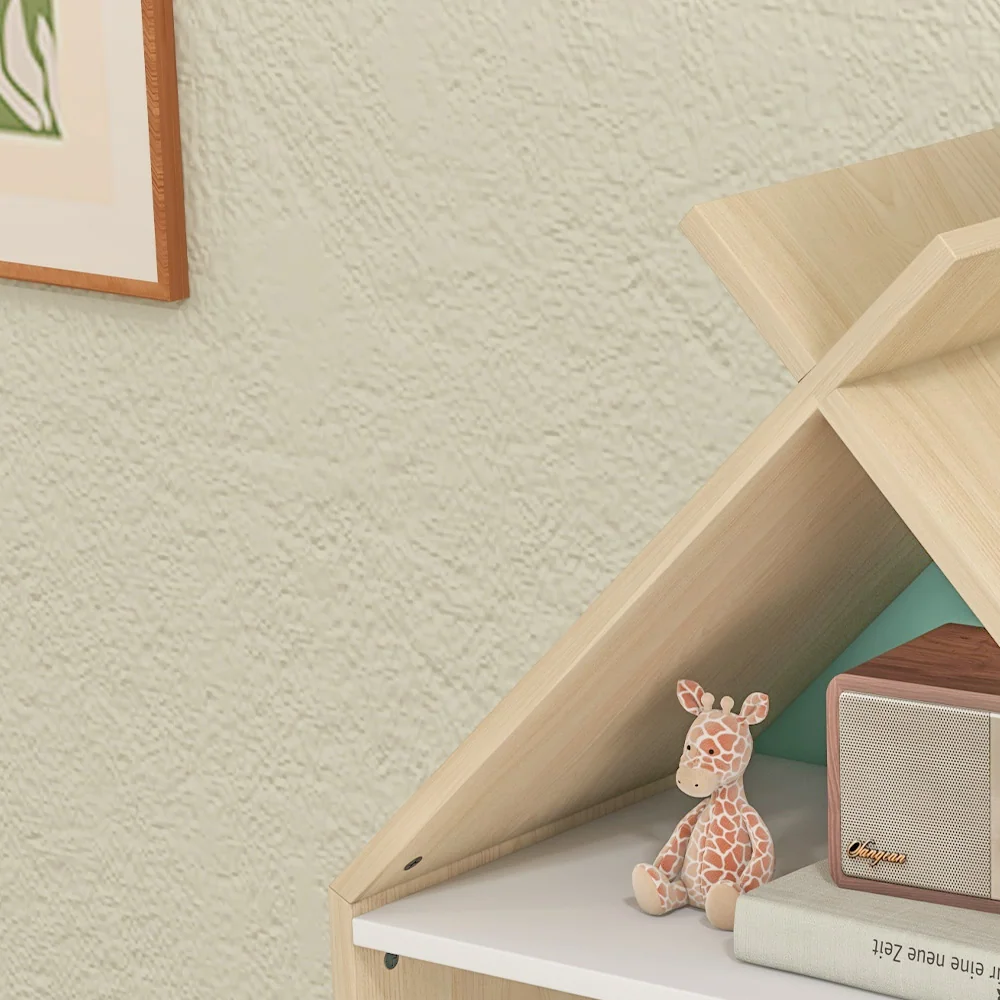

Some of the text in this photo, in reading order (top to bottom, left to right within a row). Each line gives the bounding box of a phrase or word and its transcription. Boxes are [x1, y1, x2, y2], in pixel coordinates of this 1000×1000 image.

[872, 938, 903, 963] Zeit
[907, 947, 945, 967] neue
[950, 956, 985, 980] eine
